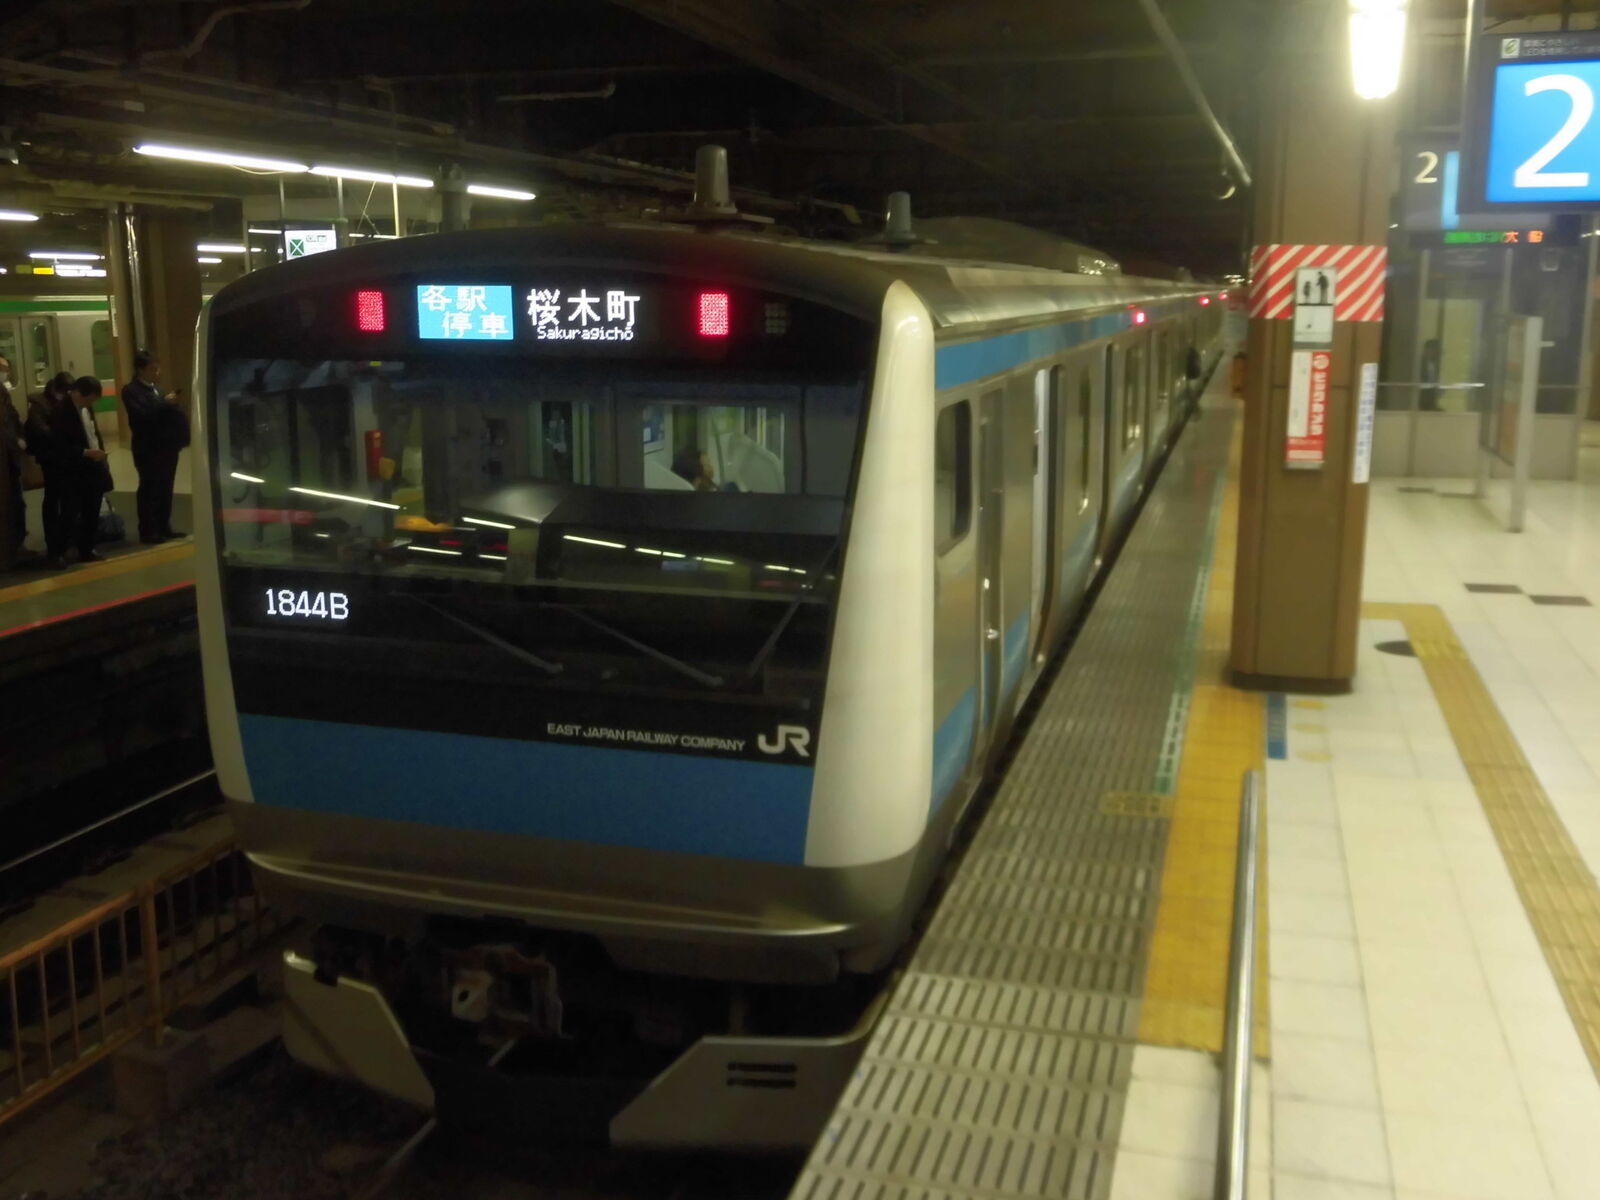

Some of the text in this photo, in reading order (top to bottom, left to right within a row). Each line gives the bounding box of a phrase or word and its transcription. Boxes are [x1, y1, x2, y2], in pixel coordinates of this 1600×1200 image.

[1514, 74, 1594, 188] 2
[1415, 151, 1439, 184] 2
[421, 285, 488, 312] 各駅
[526, 288, 641, 327] 桜木町
[442, 311, 509, 339] 停車
[265, 588, 349, 619] 1844B
[547, 722, 746, 751] EAST JAPAN RAILWAY COMPANY
[757, 724, 811, 757] JR
